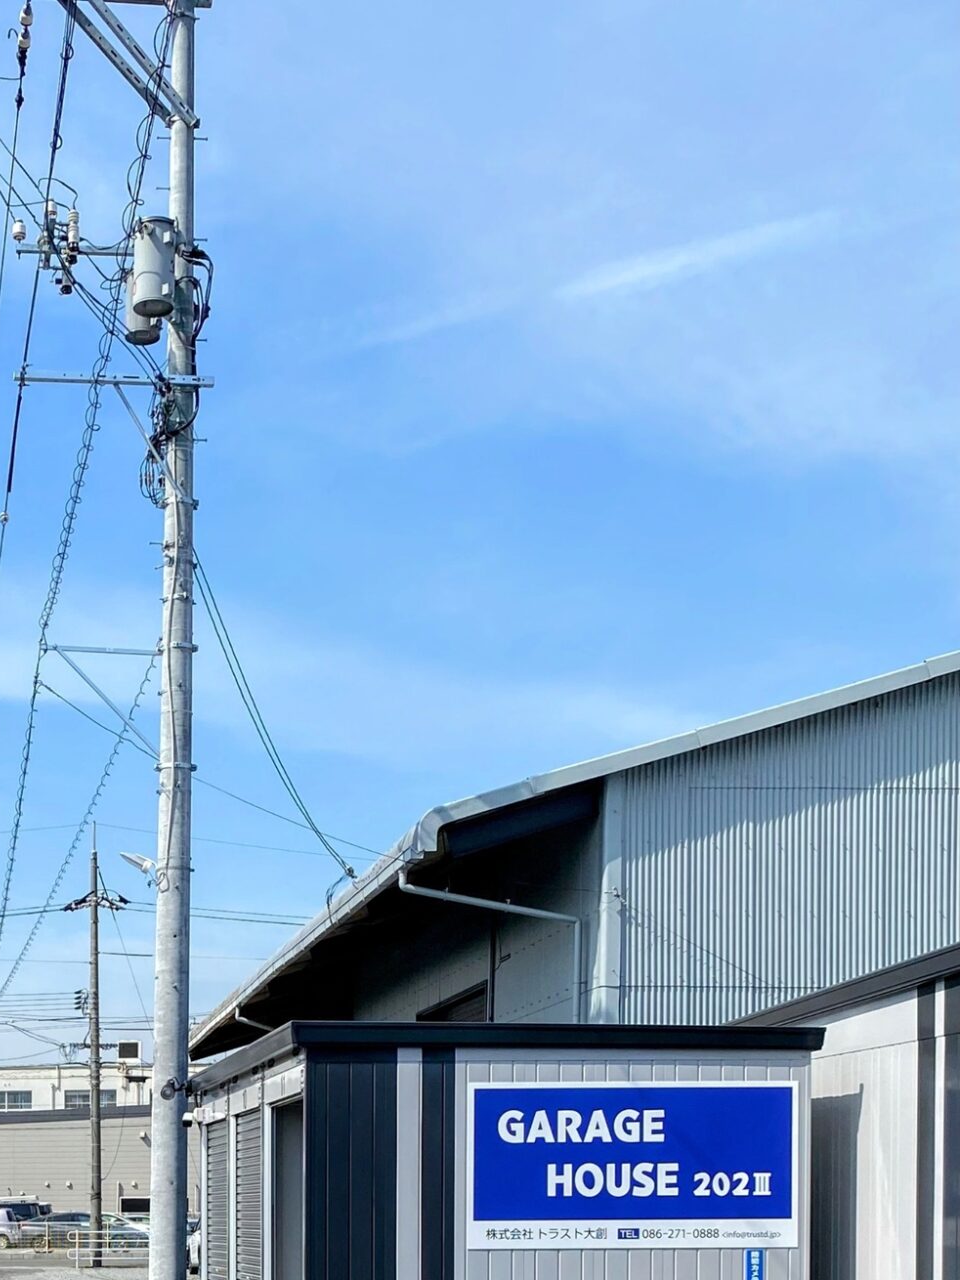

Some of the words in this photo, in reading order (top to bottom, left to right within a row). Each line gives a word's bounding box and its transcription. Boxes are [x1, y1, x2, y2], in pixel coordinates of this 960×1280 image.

[497, 1109, 666, 1143] GARAGE
[547, 1162, 679, 1197] HOUSE
[619, 1229, 639, 1238] TEL
[641, 1228, 720, 1239] 086-271-0888
